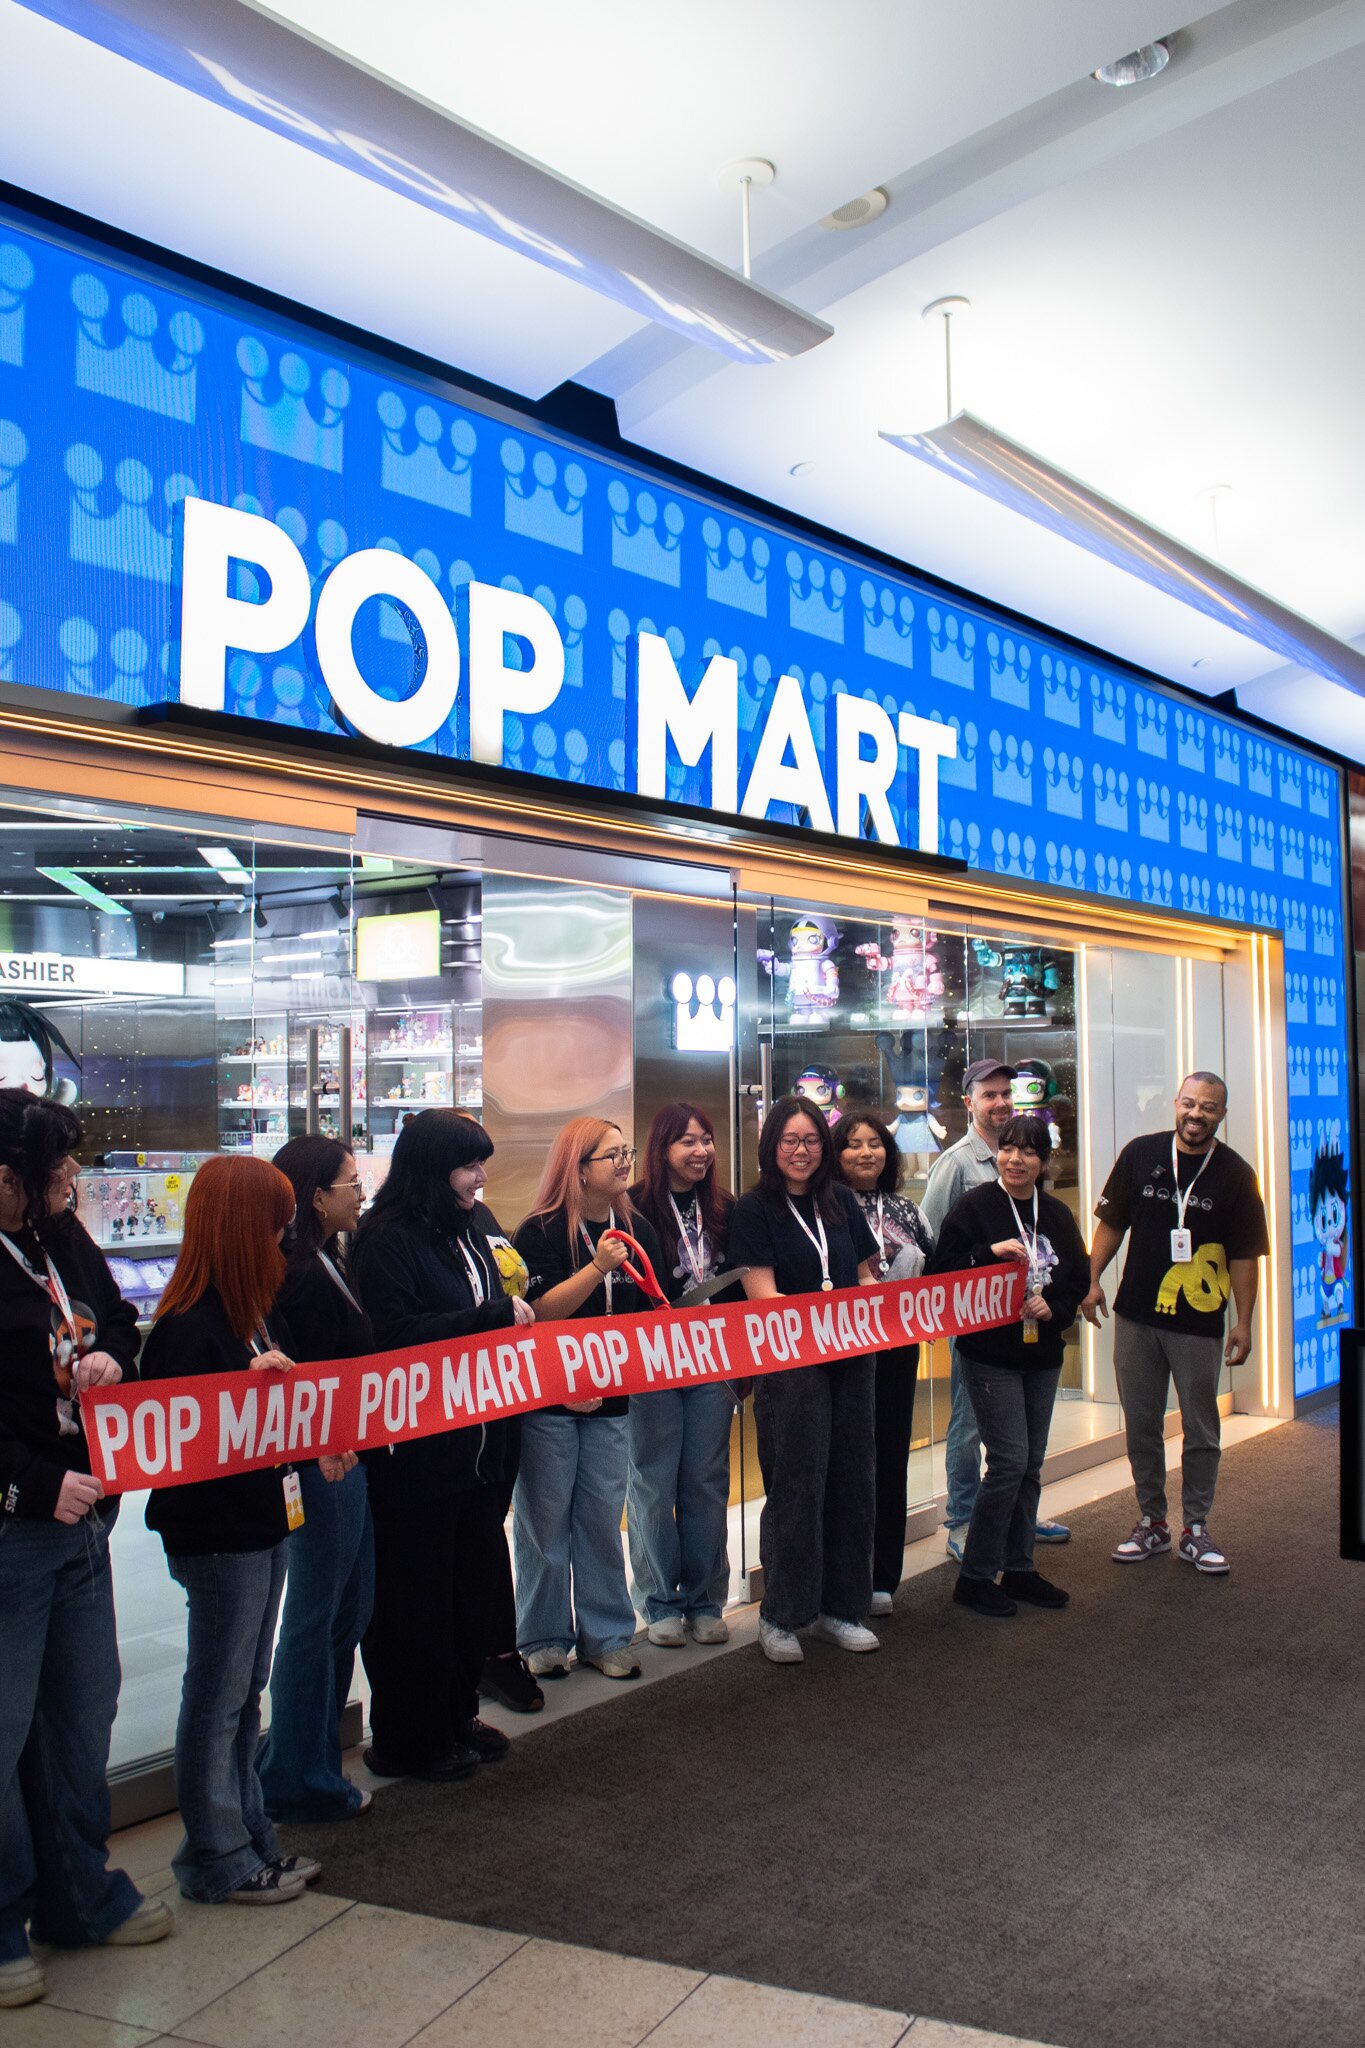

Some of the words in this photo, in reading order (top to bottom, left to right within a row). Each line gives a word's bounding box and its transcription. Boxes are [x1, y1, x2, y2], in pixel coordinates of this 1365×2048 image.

[180, 495, 565, 765] POP
[637, 631, 957, 854] MART
[95, 1395, 201, 1481] POP
[217, 1376, 340, 1465] MART
[357, 1361, 431, 1440] POP
[442, 1339, 542, 1420] MART
[556, 1329, 629, 1393] POP
[635, 1317, 732, 1382] MART
[744, 1308, 803, 1366] POP
[810, 1295, 890, 1355] MART
[899, 1286, 946, 1338] POP
[953, 1271, 1018, 1328] MART
[4, 1482, 20, 1513] STAFF
